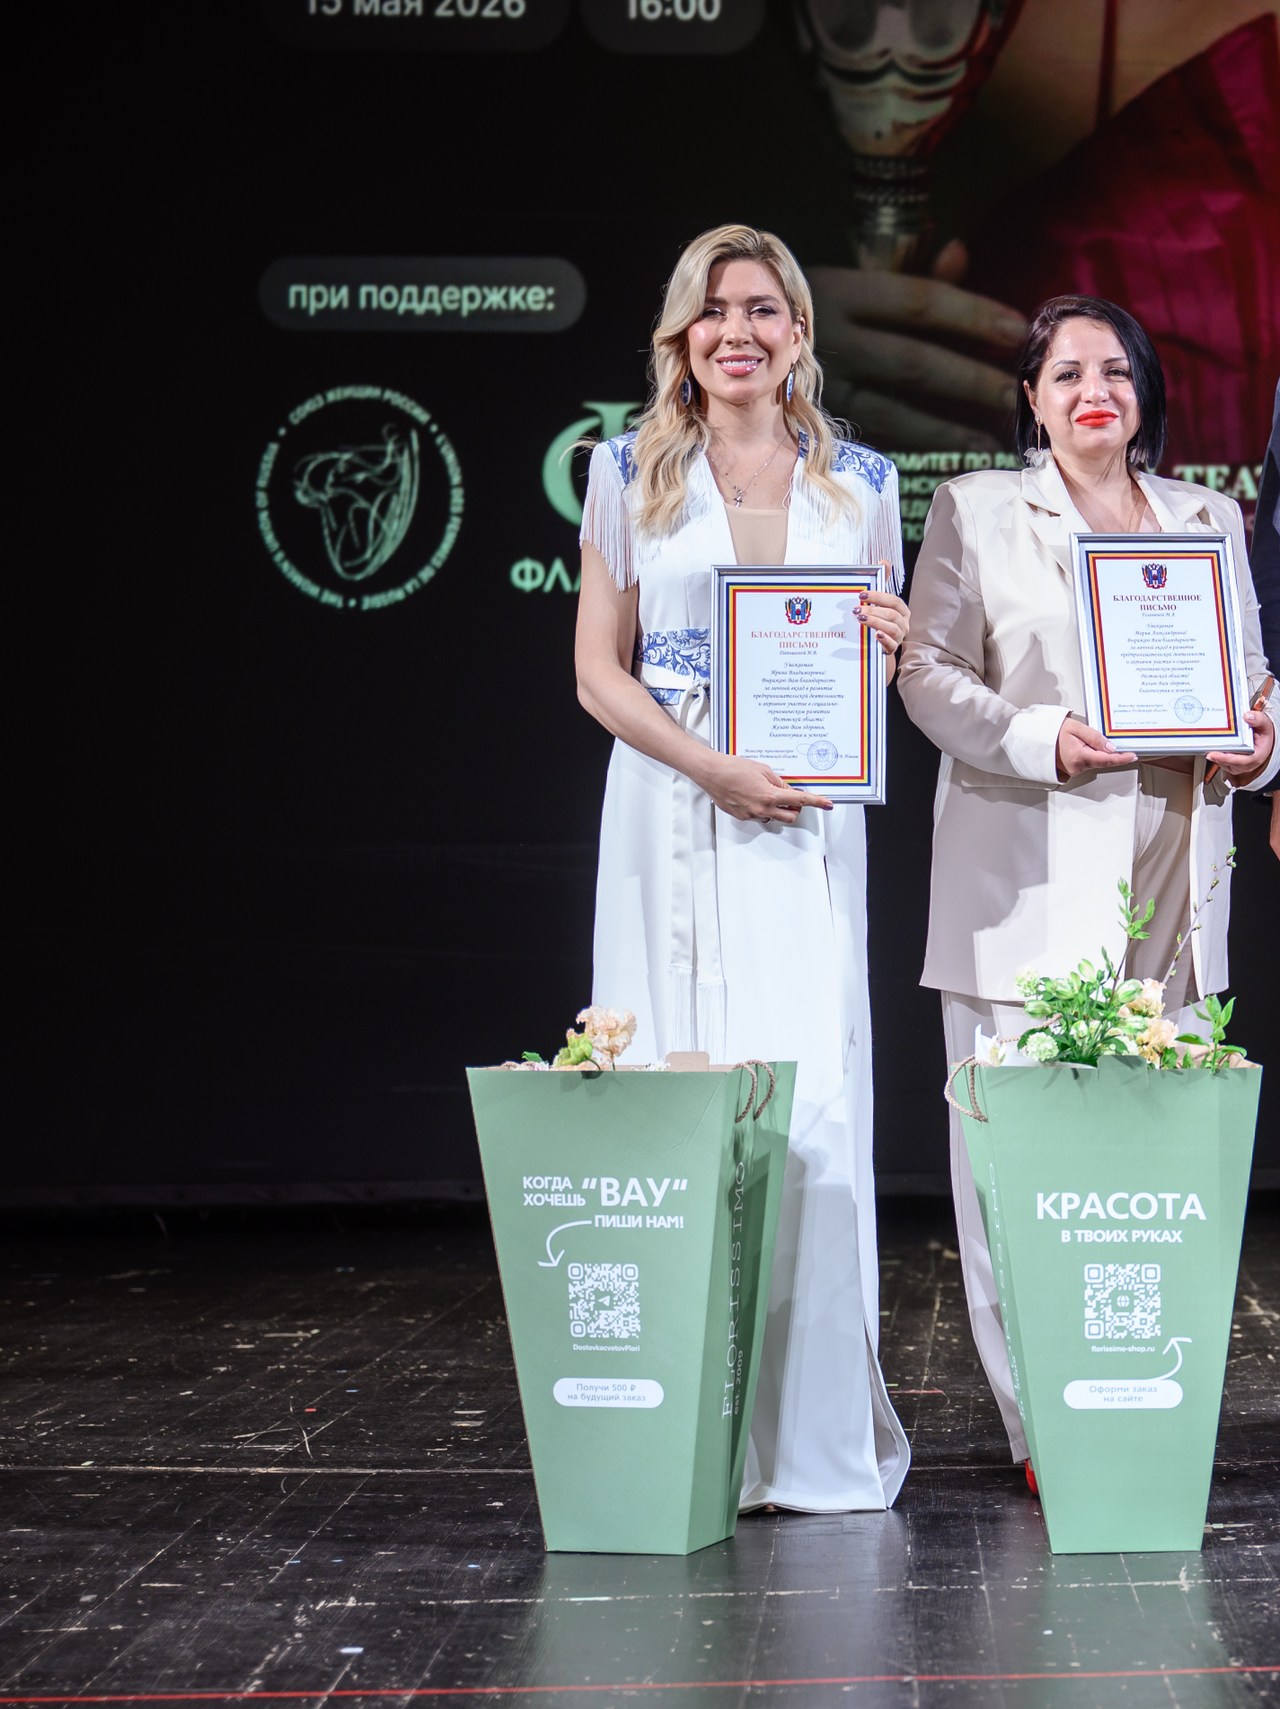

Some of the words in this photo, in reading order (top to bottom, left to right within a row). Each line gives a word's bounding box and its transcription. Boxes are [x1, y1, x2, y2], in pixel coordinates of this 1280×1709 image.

[353, 0, 424, 16] мая
[628, 0, 722, 20] 16:00
[288, 284, 349, 316] при
[359, 284, 555, 317] поддержке:
[523, 1176, 573, 1191] КОГДА
[523, 1193, 586, 1206] ХОЧЕШЬ
[1036, 1192, 1207, 1220] КРАСОТА
[595, 1215, 642, 1228] ПИШИ
[646, 1215, 684, 1228] НАМ!
[1061, 1230, 1071, 1242] В
[1074, 1230, 1128, 1242] ТВОИХ
[1131, 1230, 1183, 1242] РУКАХ
[1091, 1345, 1155, 1353] florissimo-shop.ru
[576, 1383, 609, 1392] Получи
[612, 1384, 627, 1392] 500
[1089, 1386, 1130, 1394] Оформи
[580, 1393, 620, 1402] будущий
